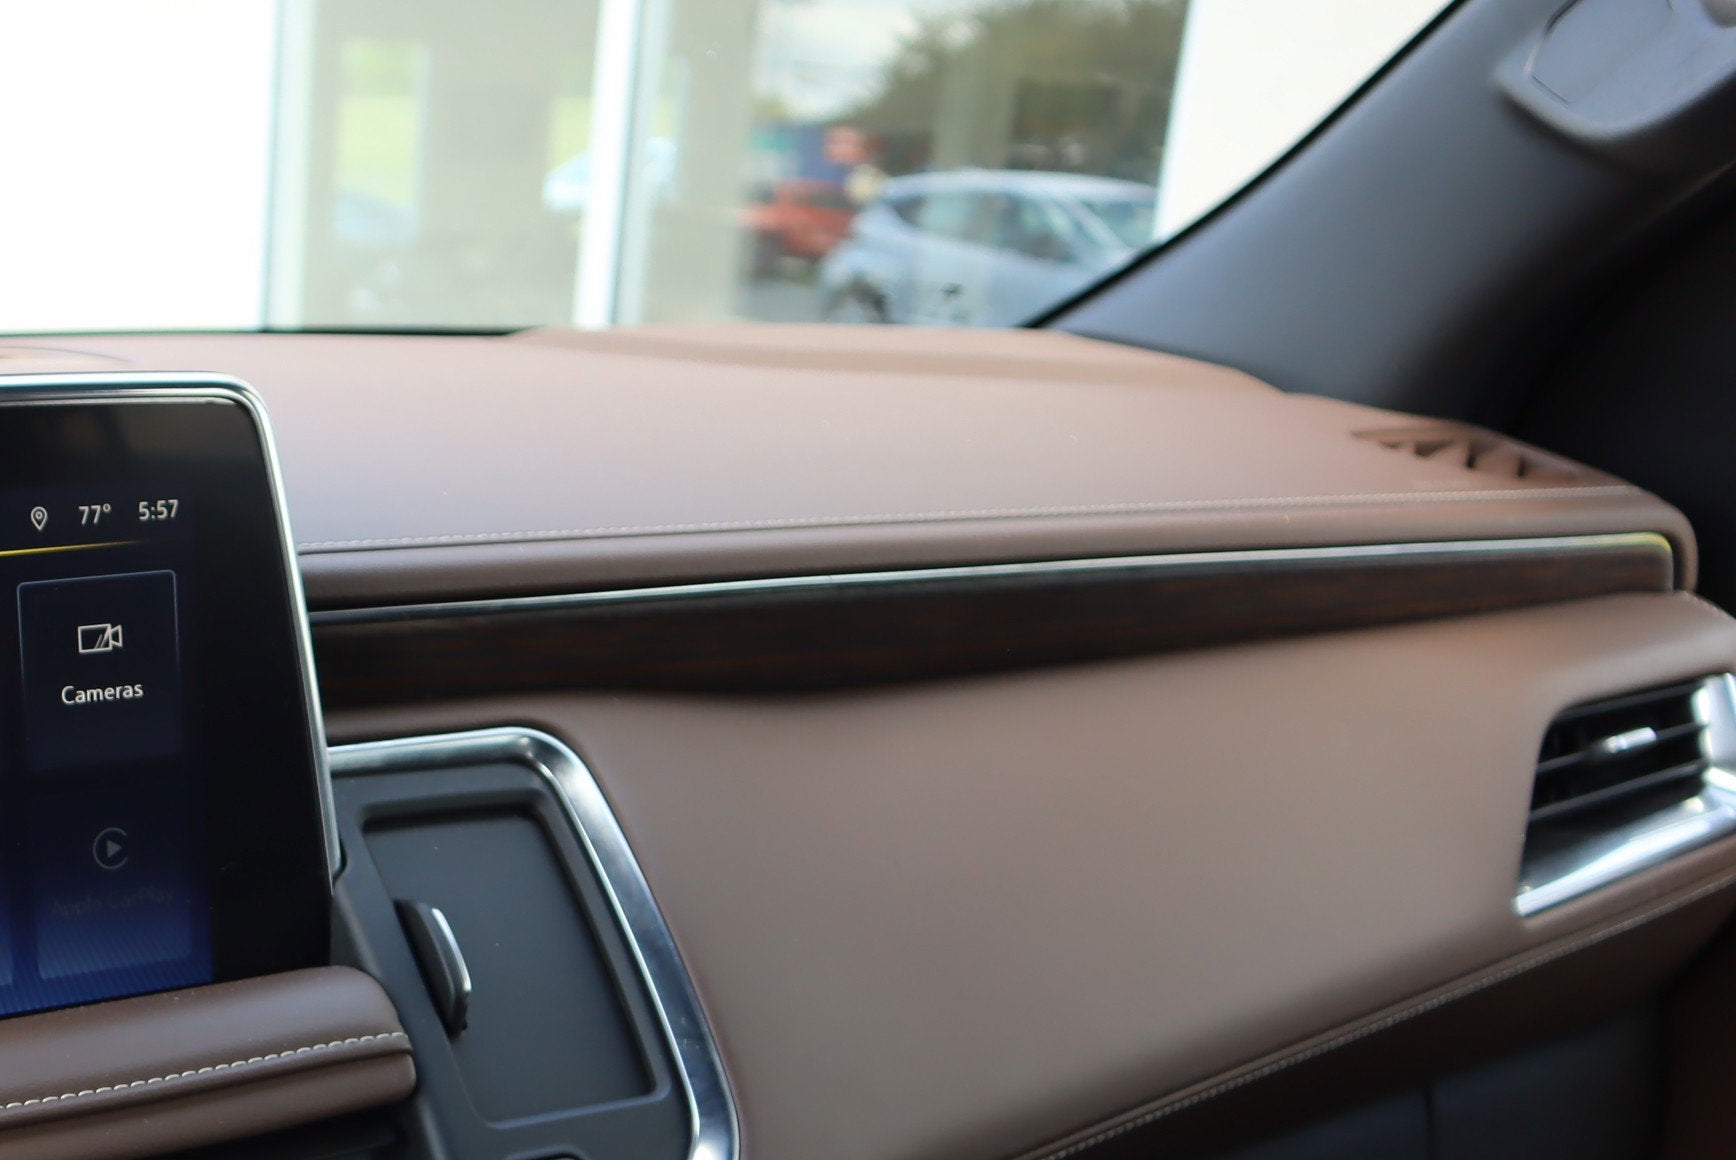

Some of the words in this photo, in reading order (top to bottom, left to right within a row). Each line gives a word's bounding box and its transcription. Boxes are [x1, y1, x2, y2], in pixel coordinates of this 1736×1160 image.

[78, 503, 111, 525] 77°
[138, 499, 179, 521] 5:57
[61, 684, 144, 705] Cameras
